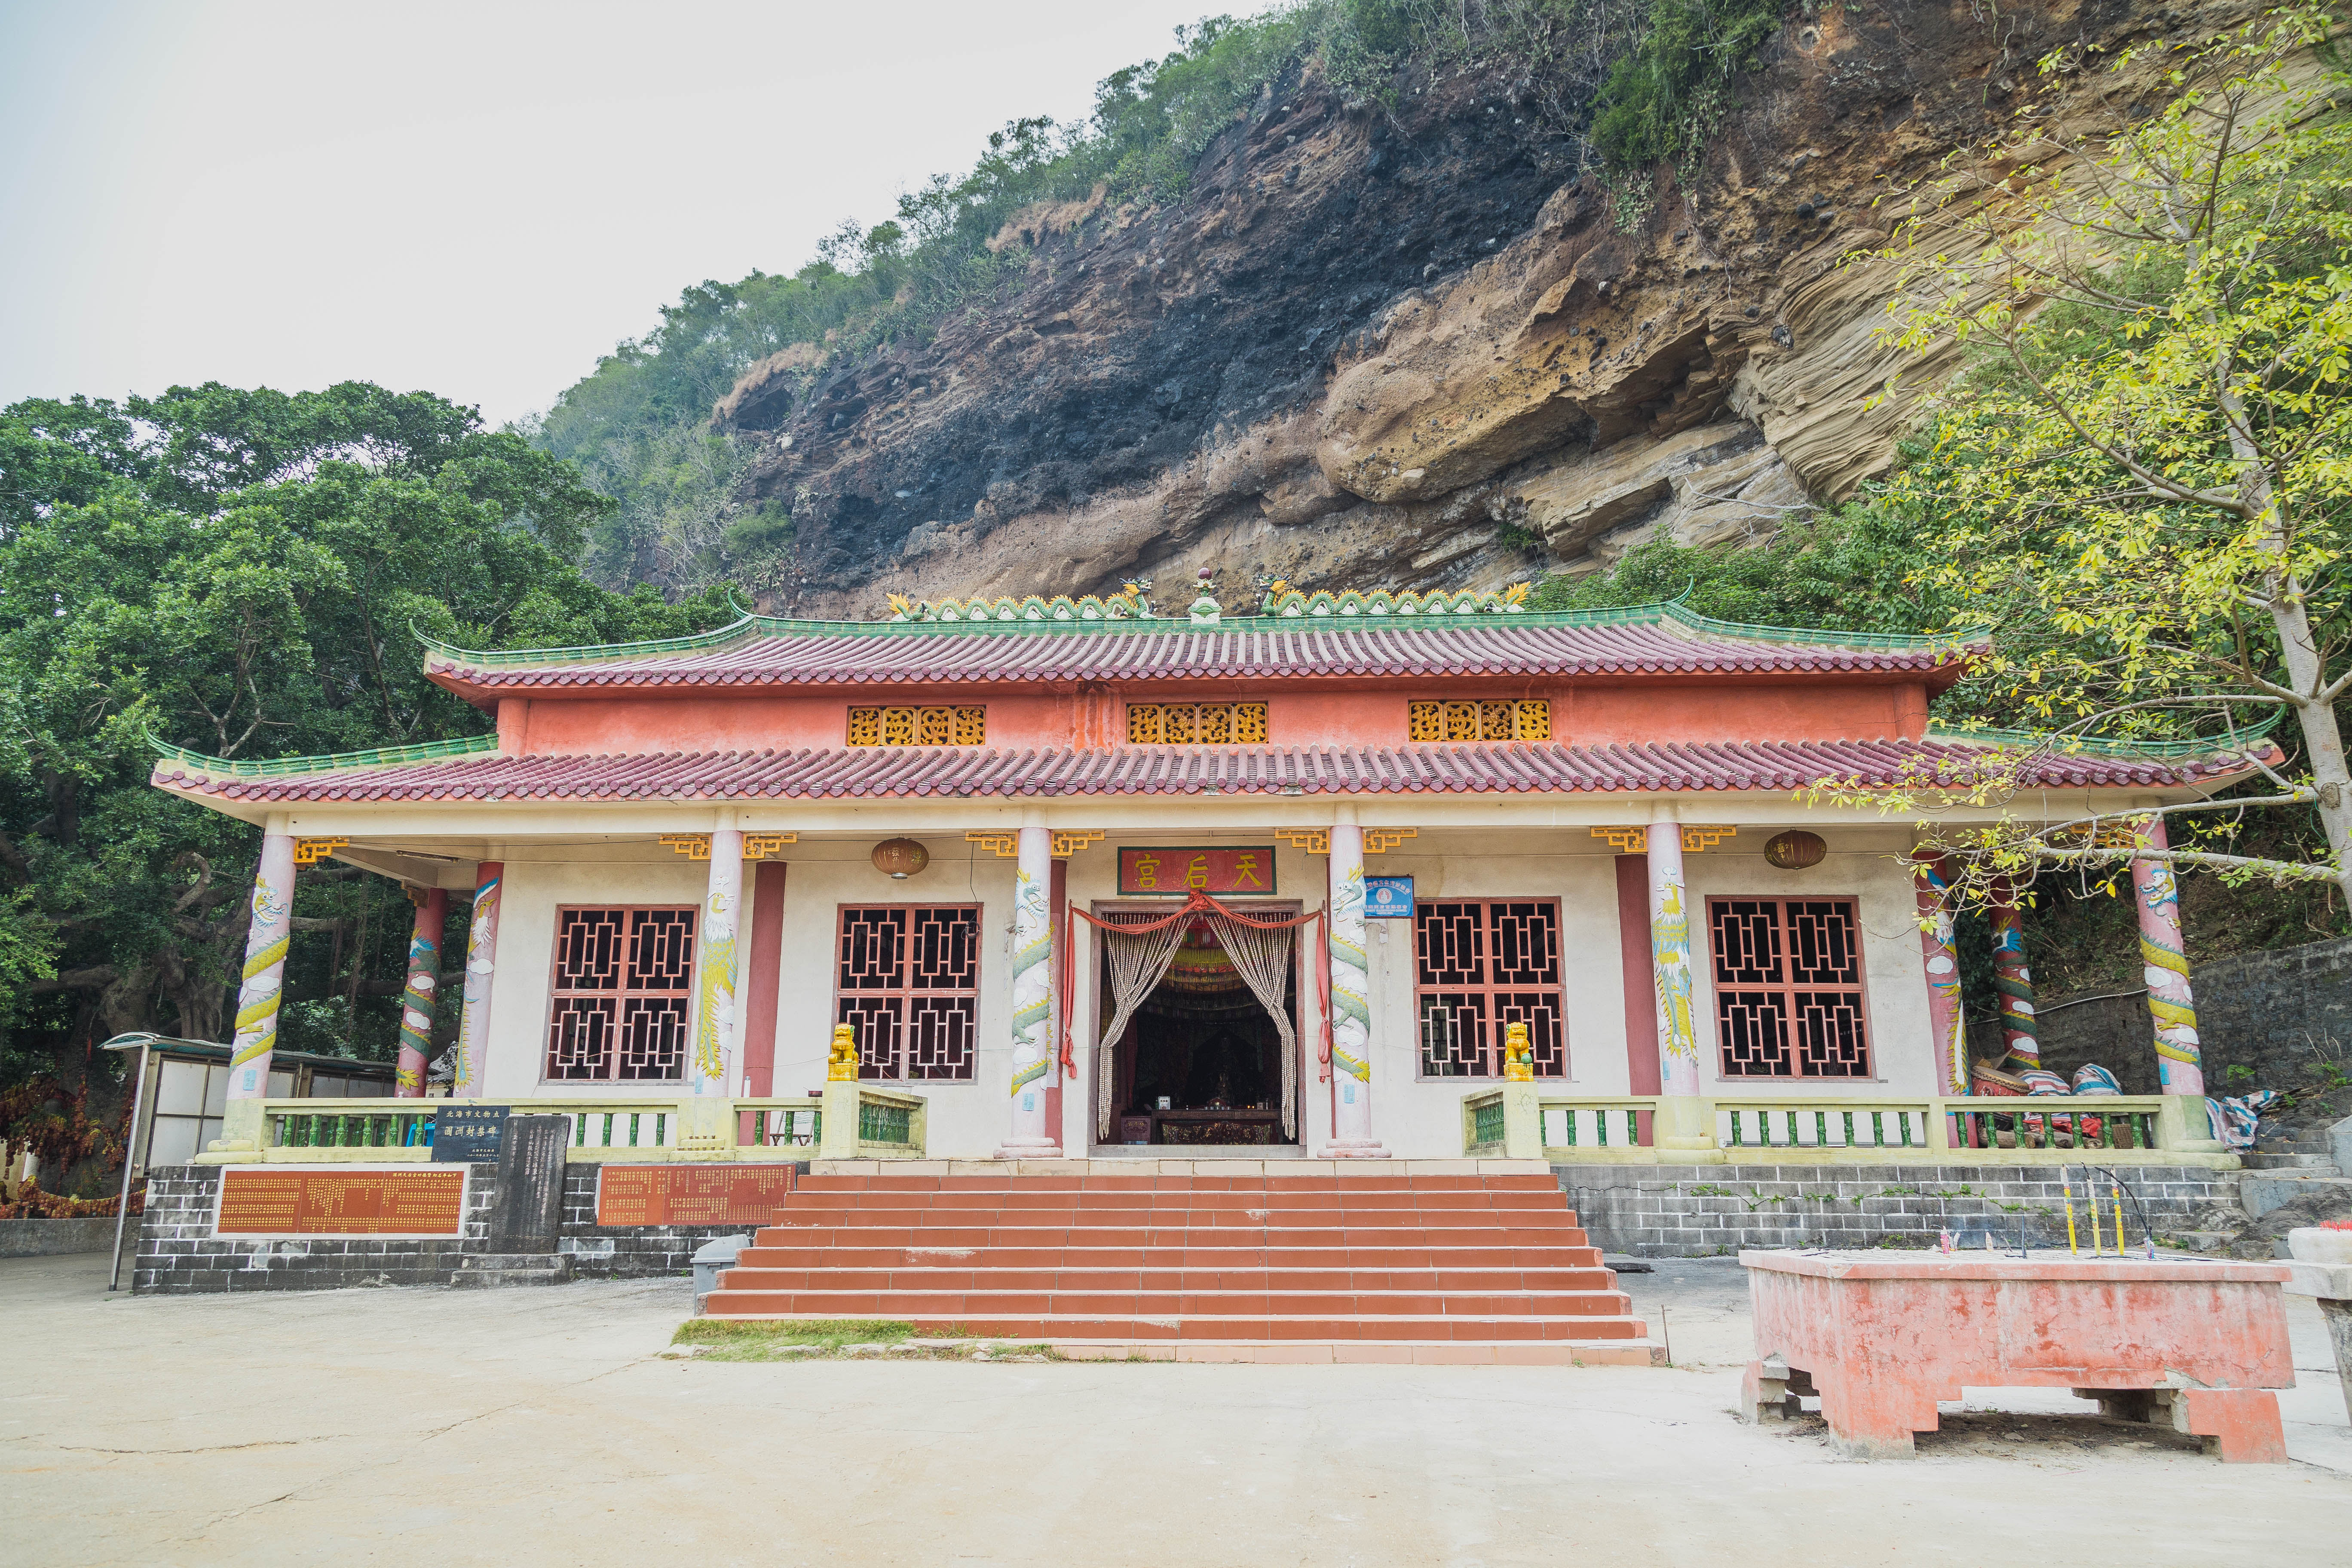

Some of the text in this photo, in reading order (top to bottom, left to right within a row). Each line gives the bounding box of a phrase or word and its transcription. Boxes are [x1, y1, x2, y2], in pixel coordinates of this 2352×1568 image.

[1135, 852, 1263, 888] 天后宫
[446, 1110, 500, 1118] 北海市文物点
[444, 1125, 497, 1137] 涠洲封禁碑
